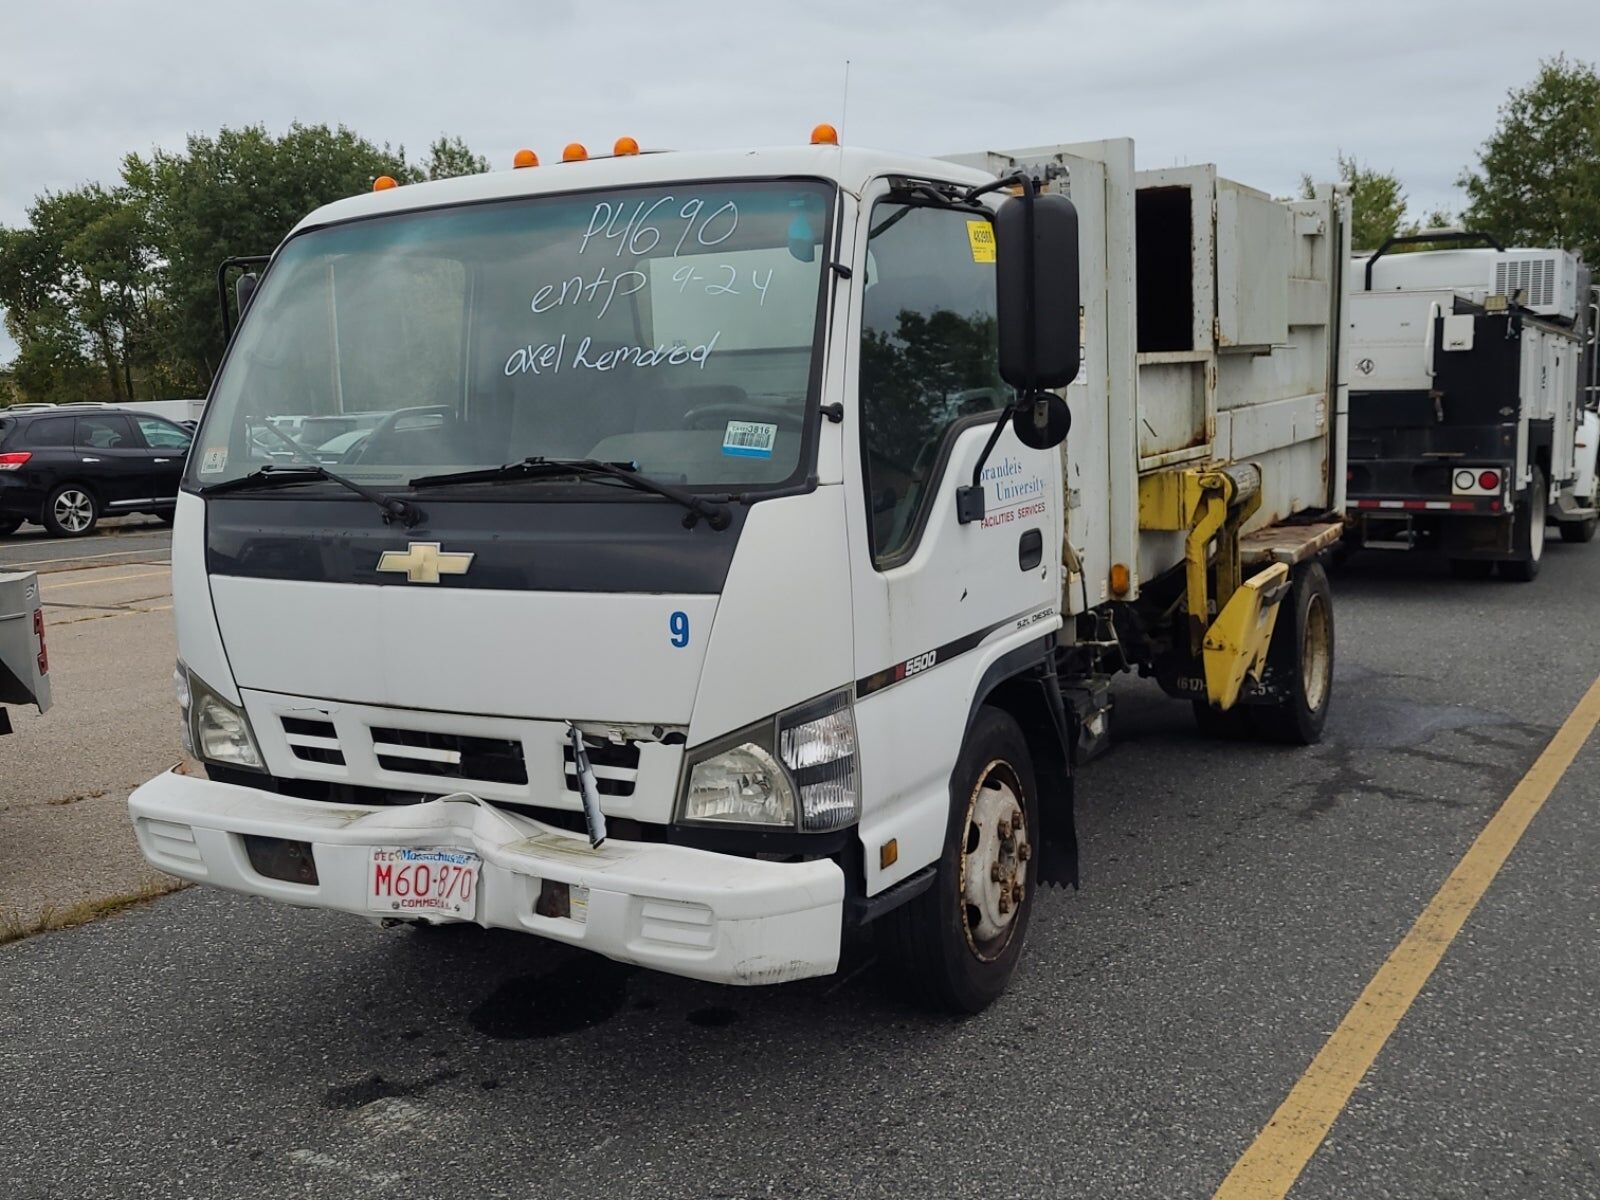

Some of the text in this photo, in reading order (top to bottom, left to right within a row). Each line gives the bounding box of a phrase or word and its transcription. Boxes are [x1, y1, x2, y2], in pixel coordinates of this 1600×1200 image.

[579, 196, 739, 257] P4690
[504, 334, 566, 376] axel
[996, 476, 1045, 501] University
[980, 502, 1046, 529] FACILITIES SERVICES
[670, 611, 690, 648] 9
